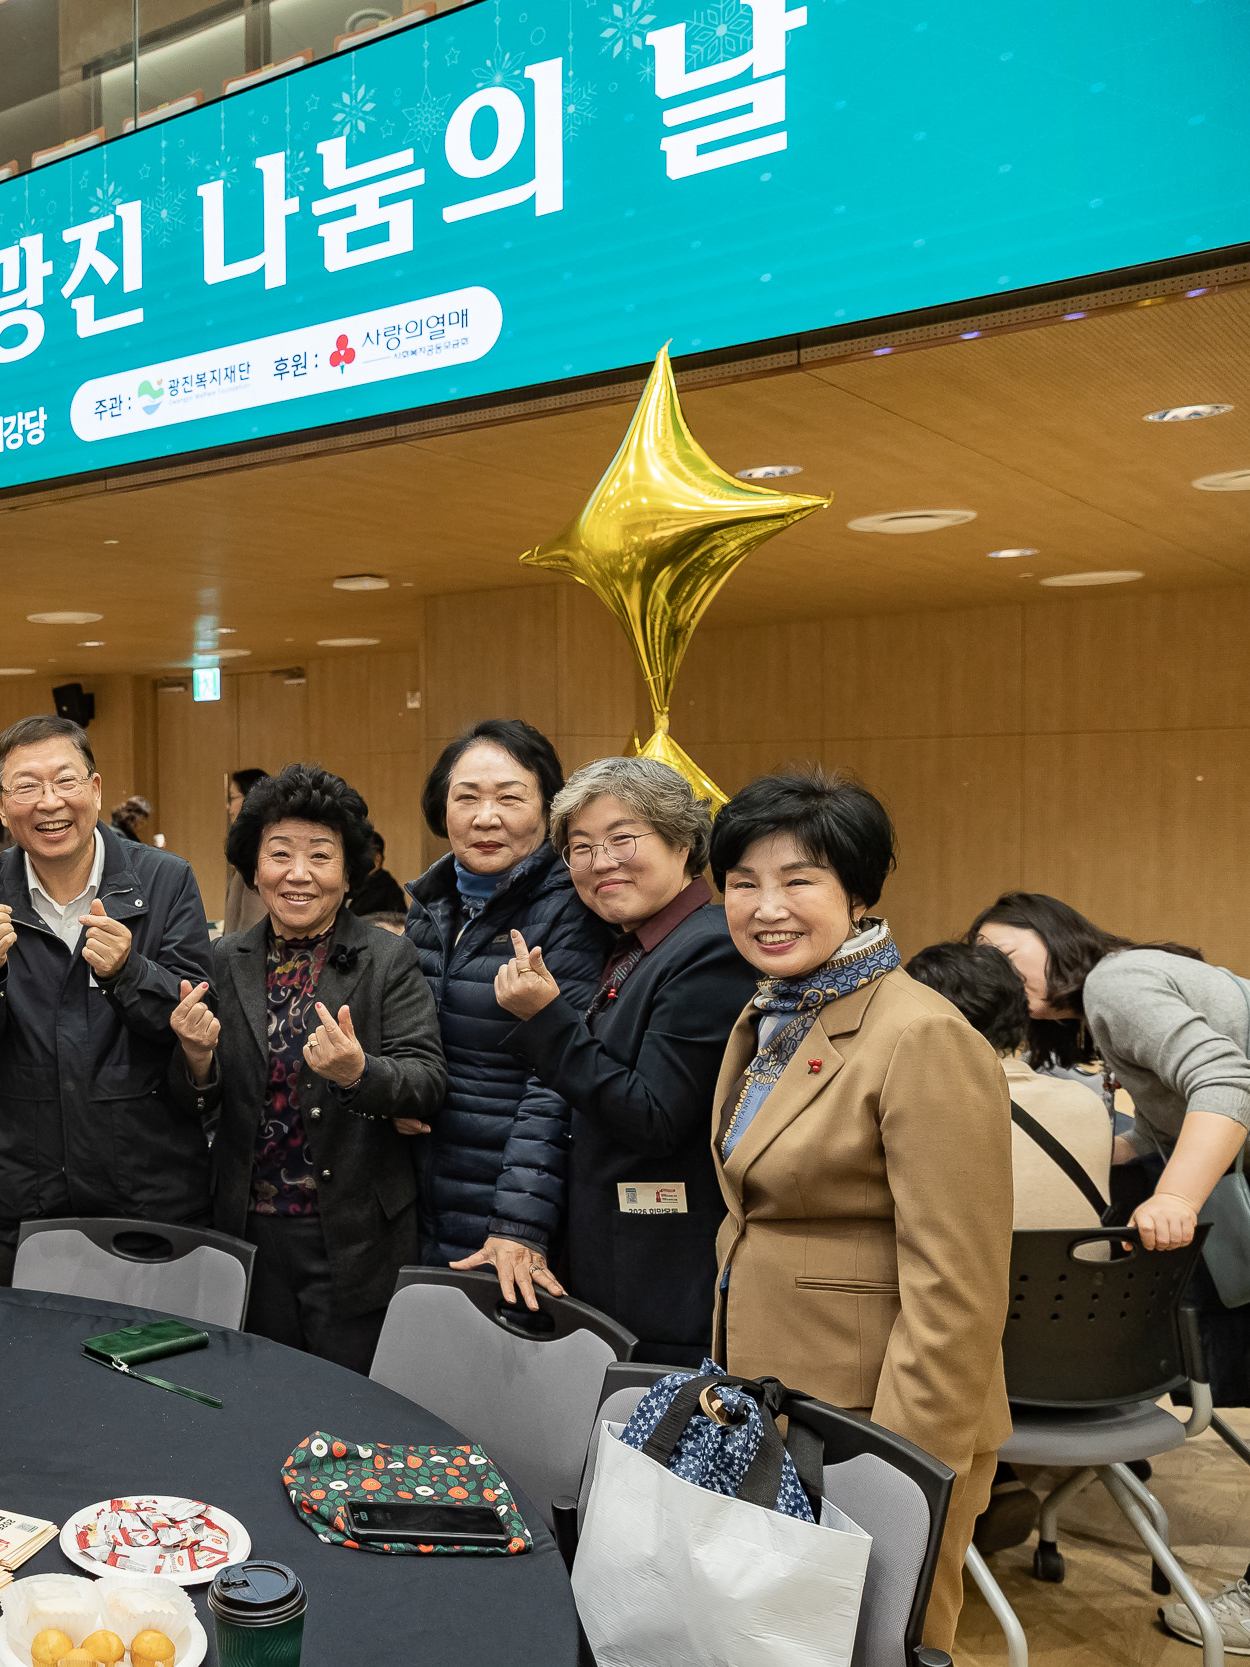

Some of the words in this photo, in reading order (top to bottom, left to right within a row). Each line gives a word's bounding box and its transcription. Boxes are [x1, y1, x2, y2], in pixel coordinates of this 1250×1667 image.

[196, 56, 564, 290] 나눔의
[645, 0, 808, 181] 날
[361, 307, 469, 351] 사랑의열매
[168, 361, 251, 397] 광진복지재단
